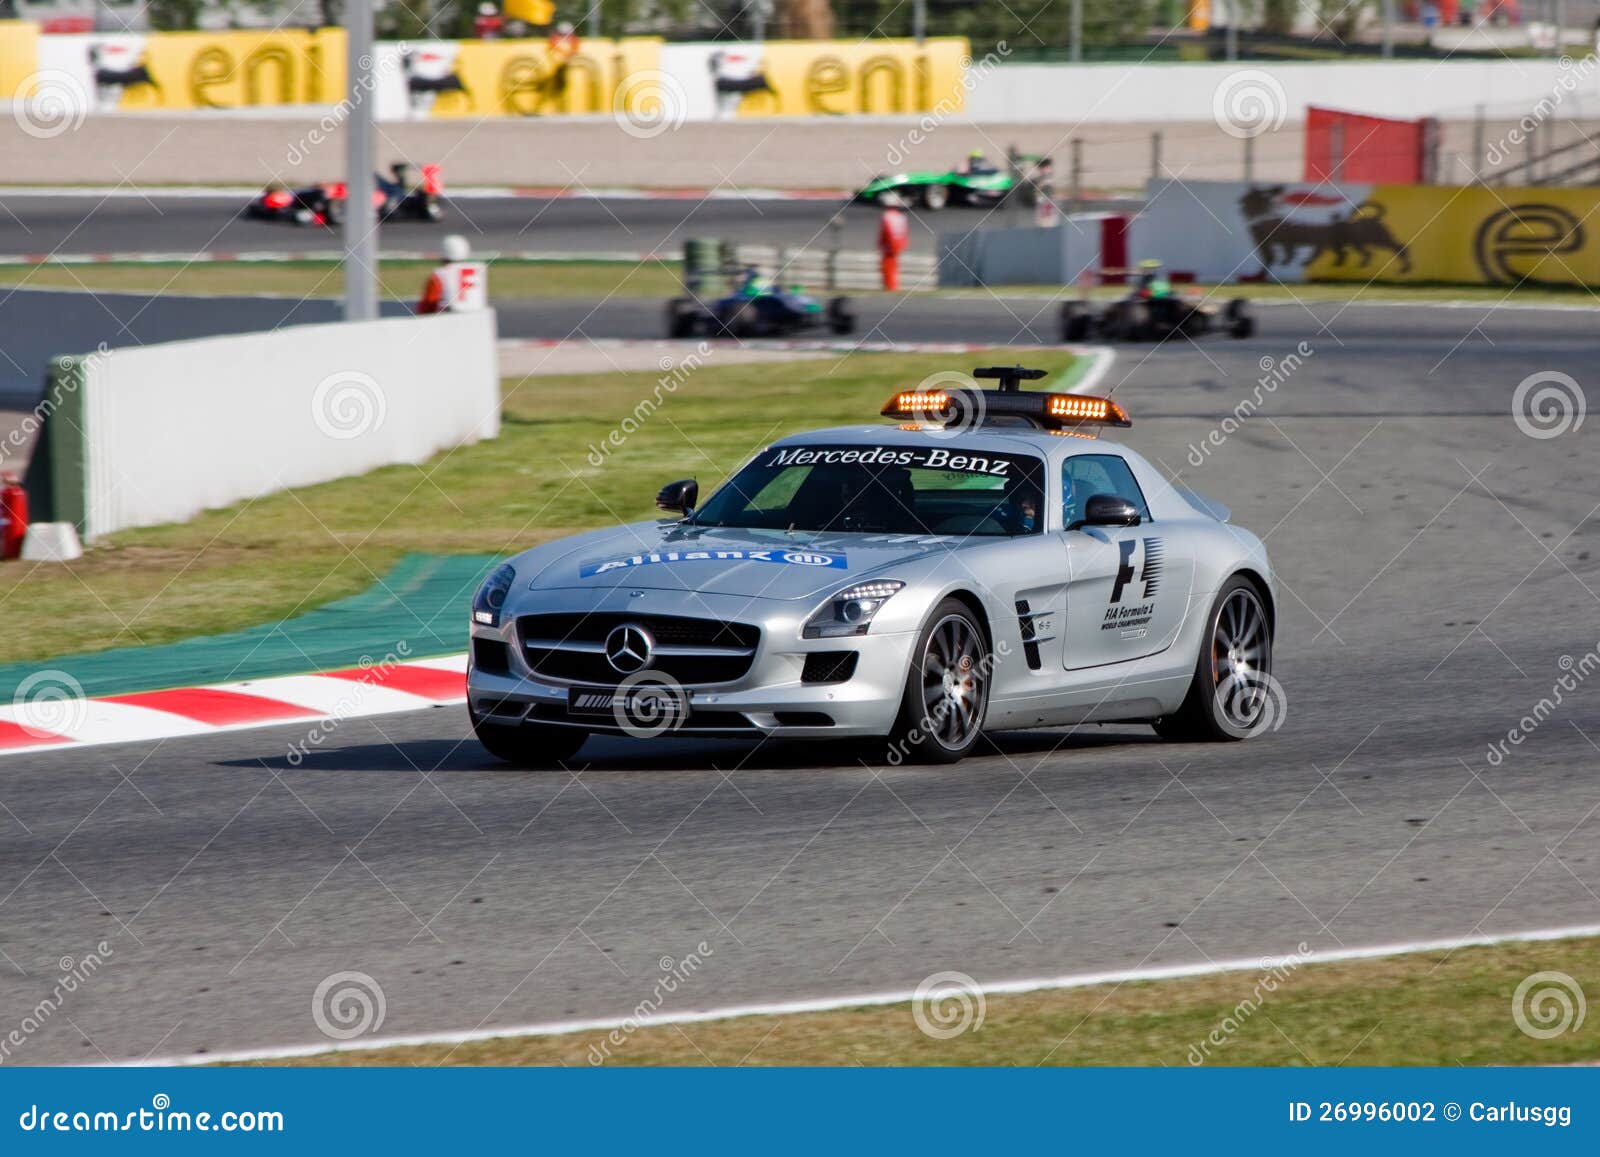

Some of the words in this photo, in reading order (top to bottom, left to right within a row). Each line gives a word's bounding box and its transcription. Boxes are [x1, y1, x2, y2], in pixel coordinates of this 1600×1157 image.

[187, 44, 322, 108] eni
[804, 54, 931, 115] eni
[458, 268, 476, 302] F
[766, 446, 1011, 475] Mercedes-Benz
[595, 550, 772, 573] Allianz
[1104, 607, 1118, 620] FIA
[1118, 604, 1149, 619] Formula
